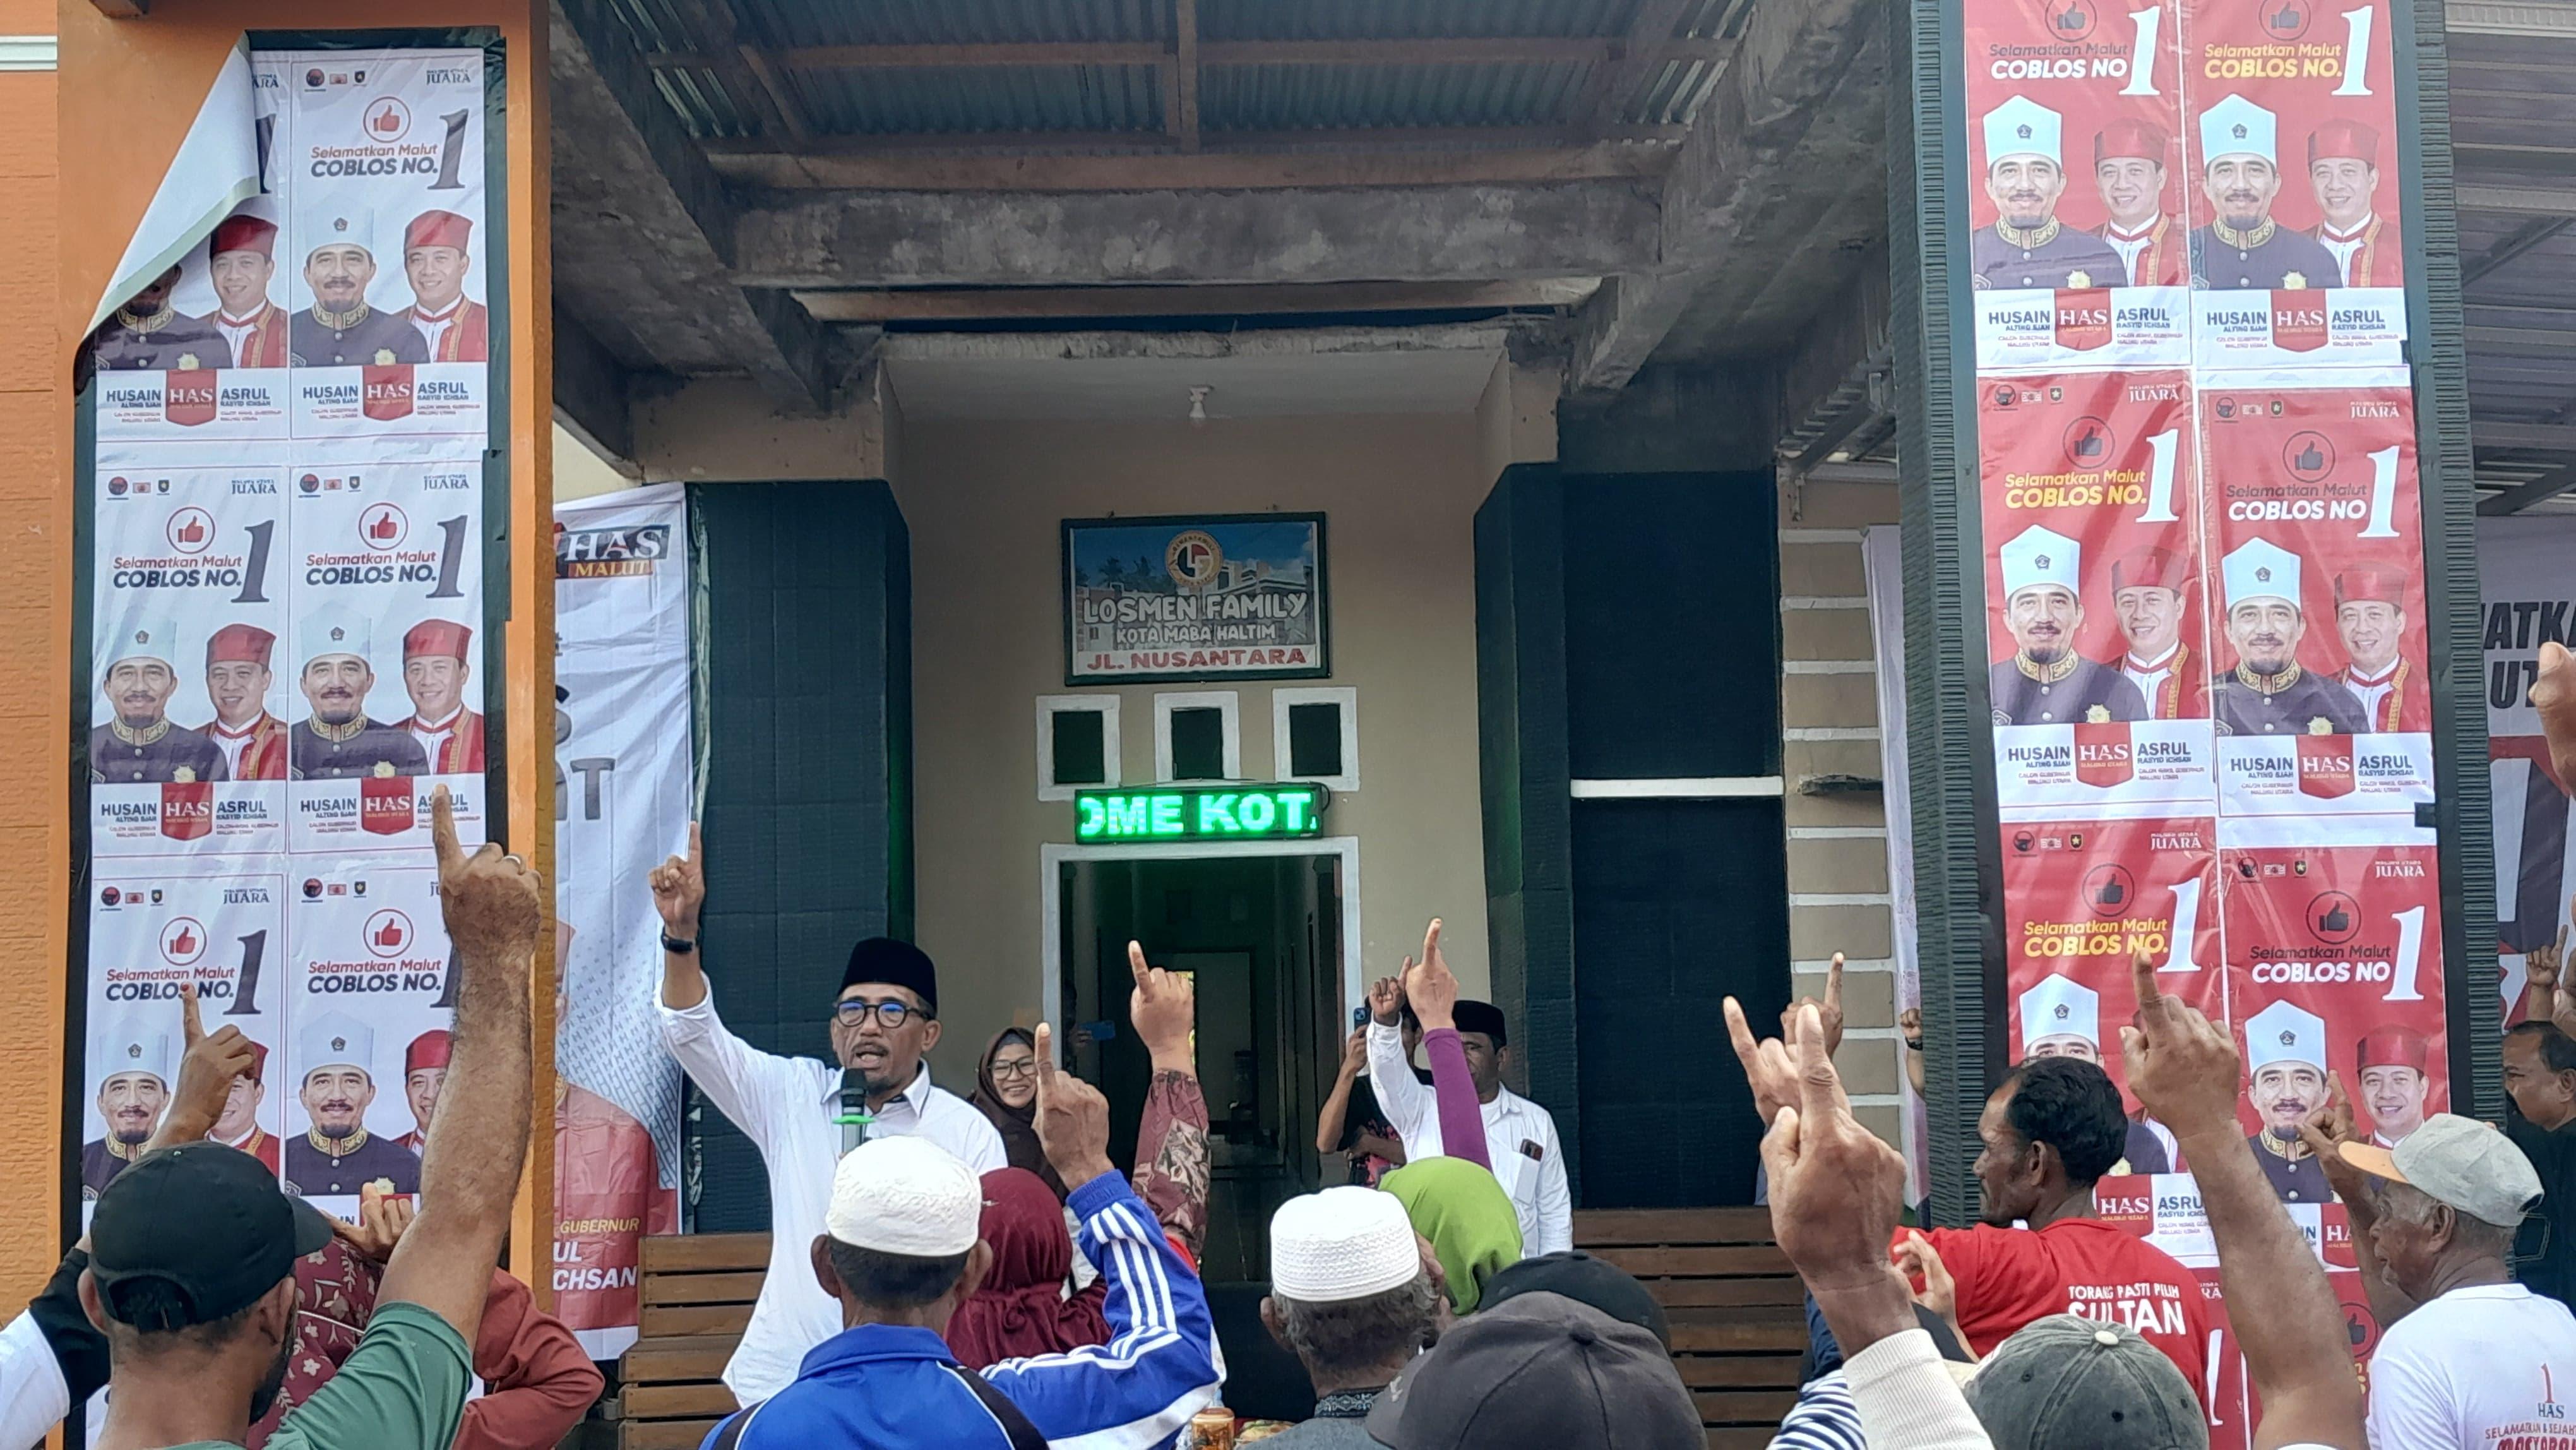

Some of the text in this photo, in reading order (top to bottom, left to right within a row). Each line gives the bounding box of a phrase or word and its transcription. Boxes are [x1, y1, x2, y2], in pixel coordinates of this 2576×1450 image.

[1989, 43, 2128, 56] Selamatkan Malut
[2118, 6, 2160, 95] 1
[2205, 42, 2341, 57] Selamatkan Malut
[2332, 5, 2373, 95] 1
[1991, 59, 2086, 79] COBLOS
[2205, 59, 2342, 78] COBLOS NO.
[252, 78, 279, 88] ARA
[426, 73, 470, 85] JUARA
[311, 143, 437, 159] Selamatkan Malut
[427, 109, 468, 189] 1
[311, 157, 438, 177] COBLOS NO.
[1989, 311, 2049, 325] HUSAIN
[2060, 309, 2108, 325] HAS
[2116, 308, 2169, 321] ASRUL
[2207, 312, 2267, 325] HUSAIN
[2276, 310, 2323, 326] HAS
[2332, 311, 2383, 323] ASRUL
[221, 388, 270, 400] ASRUL
[303, 385, 358, 398] HUSAIN
[367, 383, 410, 398] HAS
[417, 382, 467, 394] ASRUL
[107, 390, 161, 402] HUSAIN
[170, 389, 213, 403] HAS
[2130, 390, 2179, 403] JUARA
[2351, 405, 2399, 419] JUARA
[2005, 469, 2145, 487] Selamatkan Malut
[2136, 429, 2179, 523] 1
[232, 483, 276, 494] JUARA
[424, 478, 469, 490] JUARA
[2226, 483, 2366, 497] Selamatkan Malut
[2357, 445, 2400, 537] 1
[2005, 485, 2147, 508] COBLOS NO.
[2229, 500, 2325, 520] COBLOS
[565, 527, 662, 561] HAS
[114, 555, 242, 569] Selamatkan Malut
[230, 520, 275, 603] 1
[306, 551, 436, 566] Selamatkan Malut
[426, 515, 468, 599] 1
[306, 565, 436, 585] COBLOS NO.
[574, 561, 650, 577] MALUT
[114, 569, 241, 588] COBLOS NO.
[1083, 592, 1307, 623] LOSMEN FAMILY
[2481, 601, 2576, 649] ATK
[1117, 625, 1275, 643] KOTA MABA HALTIM
[1088, 648, 1306, 670] JL. NUSANTARA
[2008, 746, 2070, 761] HUSAIN
[2080, 744, 2128, 760] HAS
[2138, 743, 2190, 756] ASRUL
[2231, 757, 2293, 771] HUSAIN
[2303, 756, 2350, 772] HAS
[2359, 755, 2412, 769] ASRUL
[217, 801, 266, 813] ASRUL
[301, 798, 356, 812] HUSAIN
[365, 796, 410, 812] HAS
[418, 794, 467, 806] AUL
[102, 803, 157, 816] HUSAIN
[165, 802, 210, 816] HAS
[1200, 793, 1316, 832] KOT
[2152, 837, 2202, 850] JUARA
[2376, 866, 2424, 878] JUARA
[224, 892, 270, 904] JUARA
[2025, 918, 2167, 935] Selamatkan Malut
[2157, 877, 2202, 972] 1
[2025, 933, 2168, 957] COBLOS NO.
[2250, 945, 2391, 959] Selamatkan Malut
[2382, 906, 2424, 1000] 1
[107, 967, 235, 981] Selamatkan Malut
[222, 930, 266, 1016] 1
[309, 959, 441, 974] Selamatkan Malut
[2252, 962, 2350, 983] COBLOS
[106, 981, 233, 1000] COBLO NO.
[308, 973, 441, 993] COBLOS NO.
[2100, 1198, 2149, 1214] HAS
[2158, 1196, 2201, 1210] ASRU
[560, 1218, 640, 1233] GUBERNUR
[2327, 1225, 2352, 1242] HA
[553, 1266, 638, 1290] CHSAN
[2117, 1283, 2149, 1298] PASTI
[2541, 1363, 2555, 1403] 1
[2538, 1403, 2564, 1418] HAS
